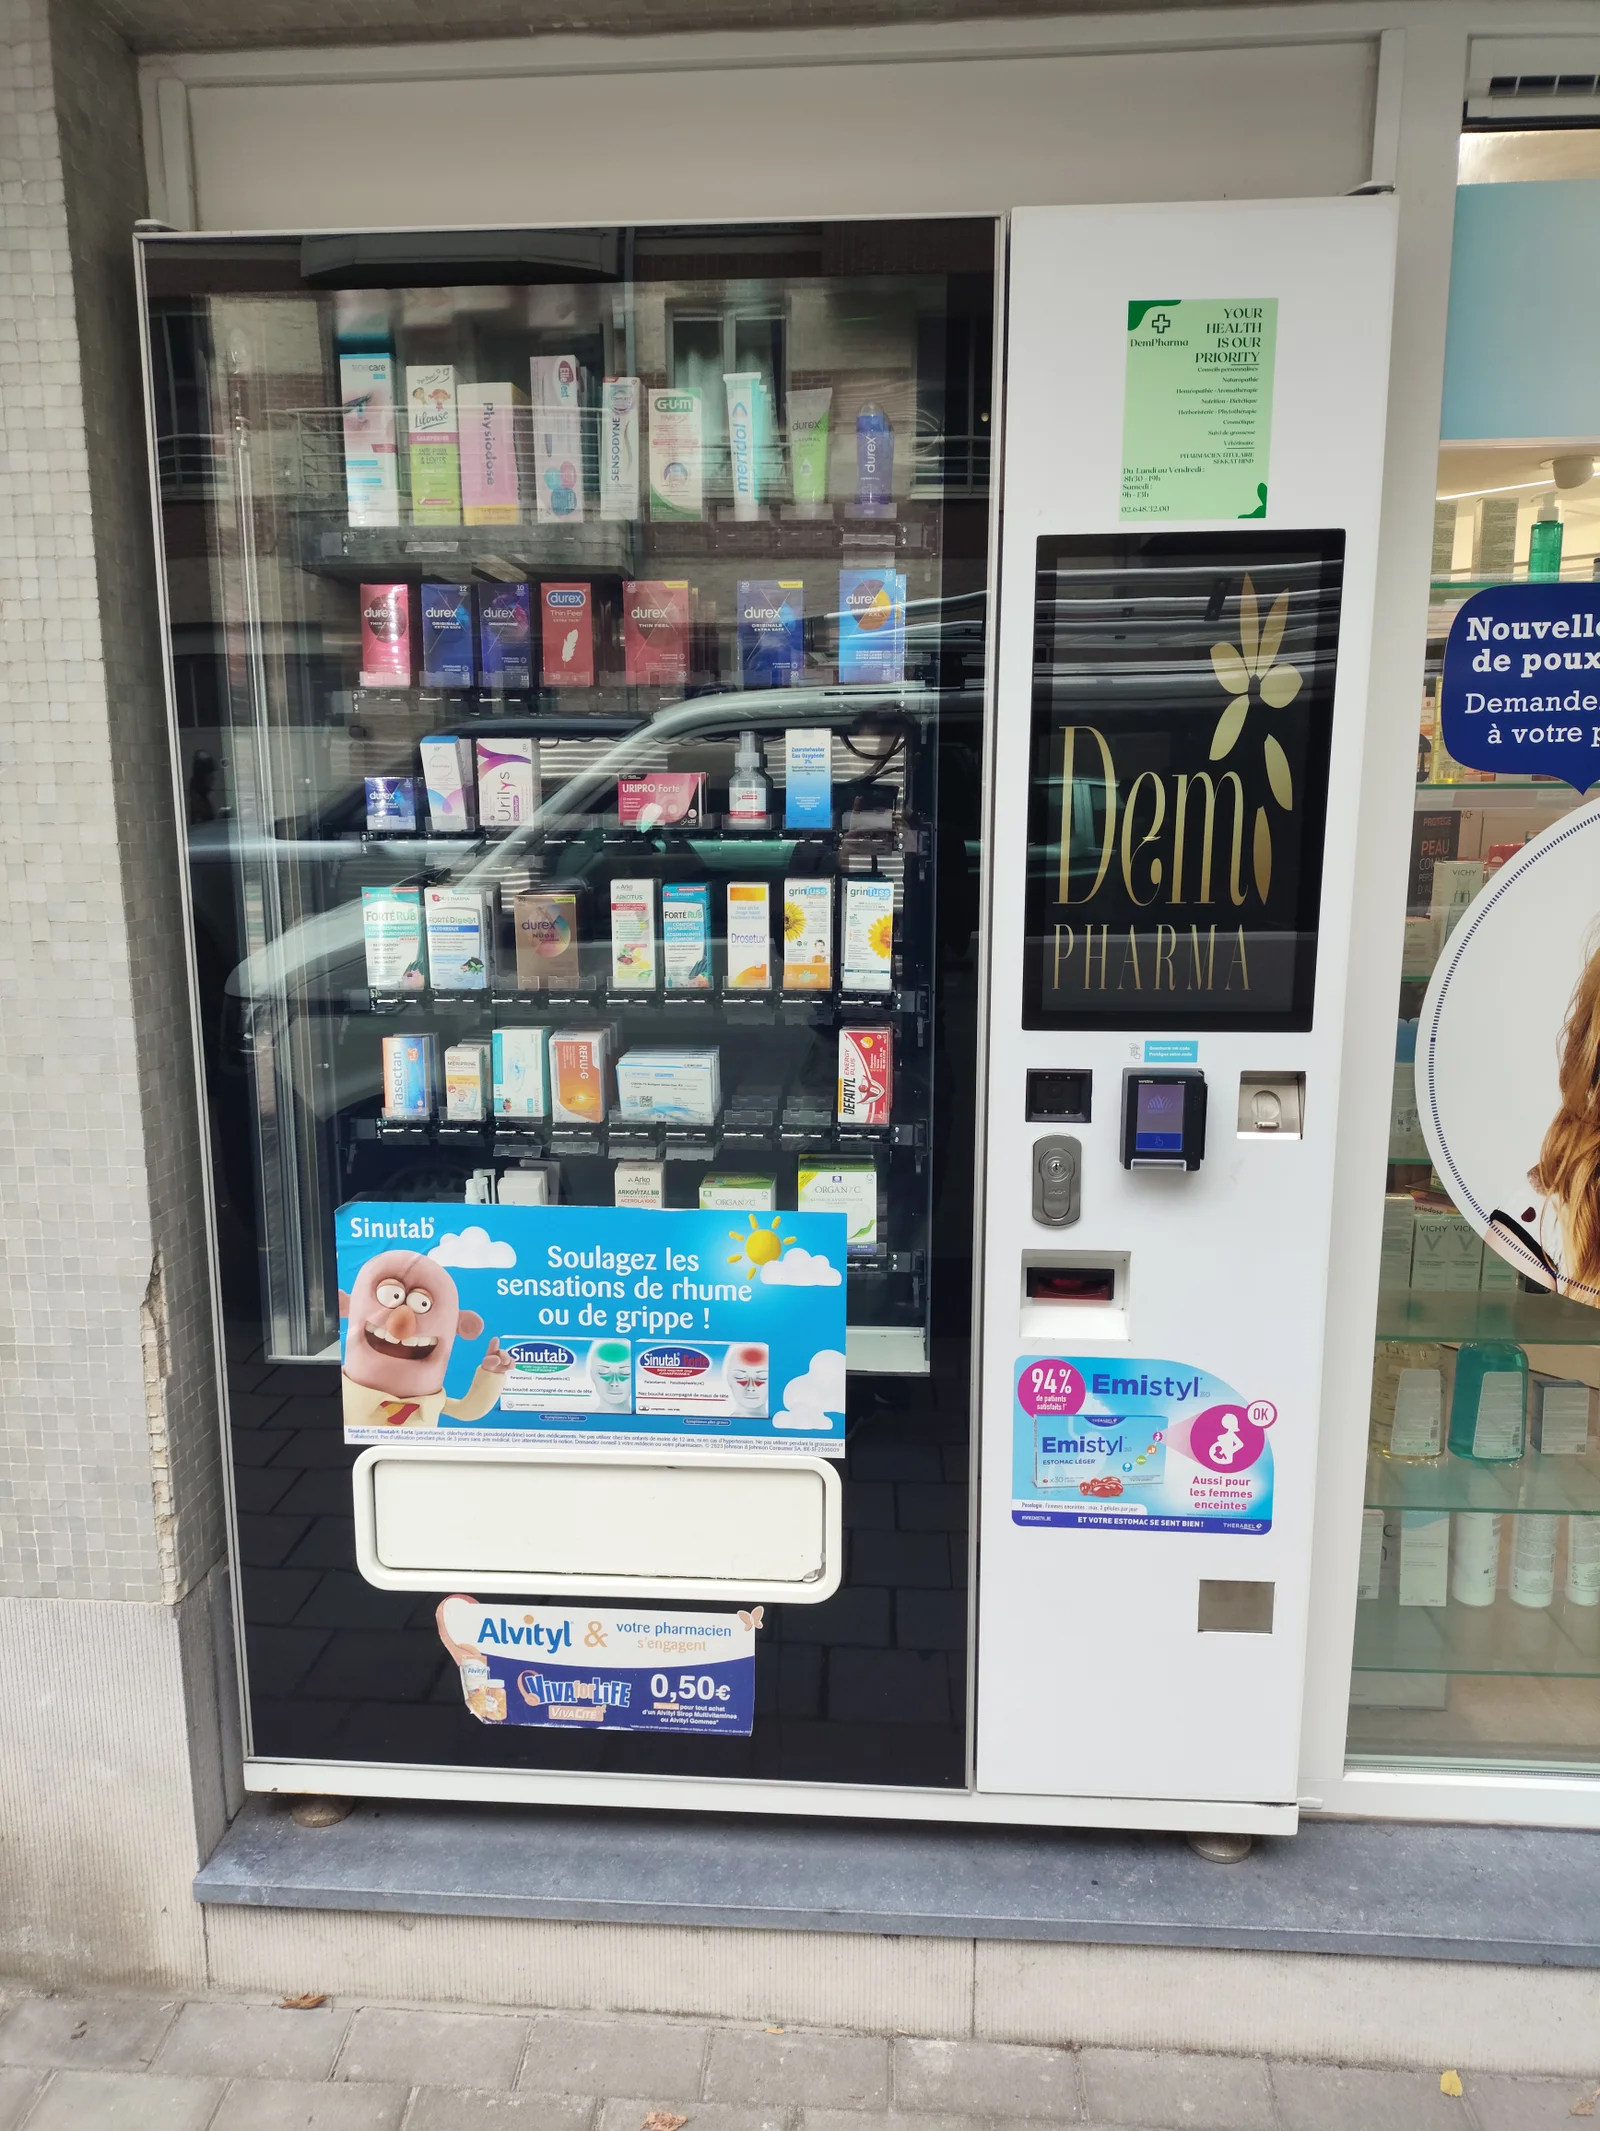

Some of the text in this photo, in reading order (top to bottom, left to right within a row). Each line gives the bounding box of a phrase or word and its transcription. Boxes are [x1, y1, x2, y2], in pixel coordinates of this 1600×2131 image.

[1224, 308, 1262, 318] YOUR
[1206, 322, 1262, 333] HEALTH
[1218, 337, 1260, 348] IS OUR
[1196, 352, 1259, 363] PRIORITY
[791, 420, 822, 431] durex
[482, 402, 495, 485] Physiodose
[611, 416, 620, 481] SENSODYNE
[731, 423, 748, 493] meridol
[865, 435, 876, 473] durex
[550, 592, 583, 604] durex
[846, 594, 878, 605] durex
[425, 607, 457, 618] durex
[483, 606, 516, 618] durex
[550, 609, 566, 618] Thin
[631, 606, 668, 619] durex
[744, 607, 781, 620] durex
[1466, 613, 1600, 642] Nouvell
[1472, 648, 1600, 679] de poux
[1488, 723, 1502, 744] à
[1511, 724, 1584, 745] votre
[622, 783, 681, 794] URIPRO Forte
[1052, 724, 1250, 907] Dem
[521, 920, 556, 931] durex
[731, 933, 766, 944] Drosetux
[1051, 923, 1252, 992] PHARMA
[579, 1045, 588, 1079] REFLU-G
[392, 1051, 403, 1108] Tasectan
[843, 1078, 855, 1114] DEFATYL
[1420, 1224, 1448, 1233] VICHY
[547, 1245, 699, 1273] Soulagez les
[496, 1275, 752, 1303] sensations de rhume
[538, 1304, 710, 1335] ou de grippe !
[682, 1354, 708, 1367] Forte
[1031, 1368, 1072, 1395] 94%
[1092, 1373, 1200, 1402] Emistyl
[1044, 1395, 1066, 1404] patients
[1253, 1408, 1268, 1421] OK
[1042, 1435, 1123, 1456] Emistyl
[1192, 1476, 1250, 1488] Aussi pour
[1190, 1487, 1253, 1499] les femmes
[1194, 1500, 1248, 1510] enceintes
[477, 1614, 609, 1653] Alvityl &
[616, 1622, 732, 1636] votre pharmacien
[638, 1638, 706, 1653] s'engagent
[650, 1673, 731, 1703] 0,50€
[676, 1710, 693, 1719] Sirop
